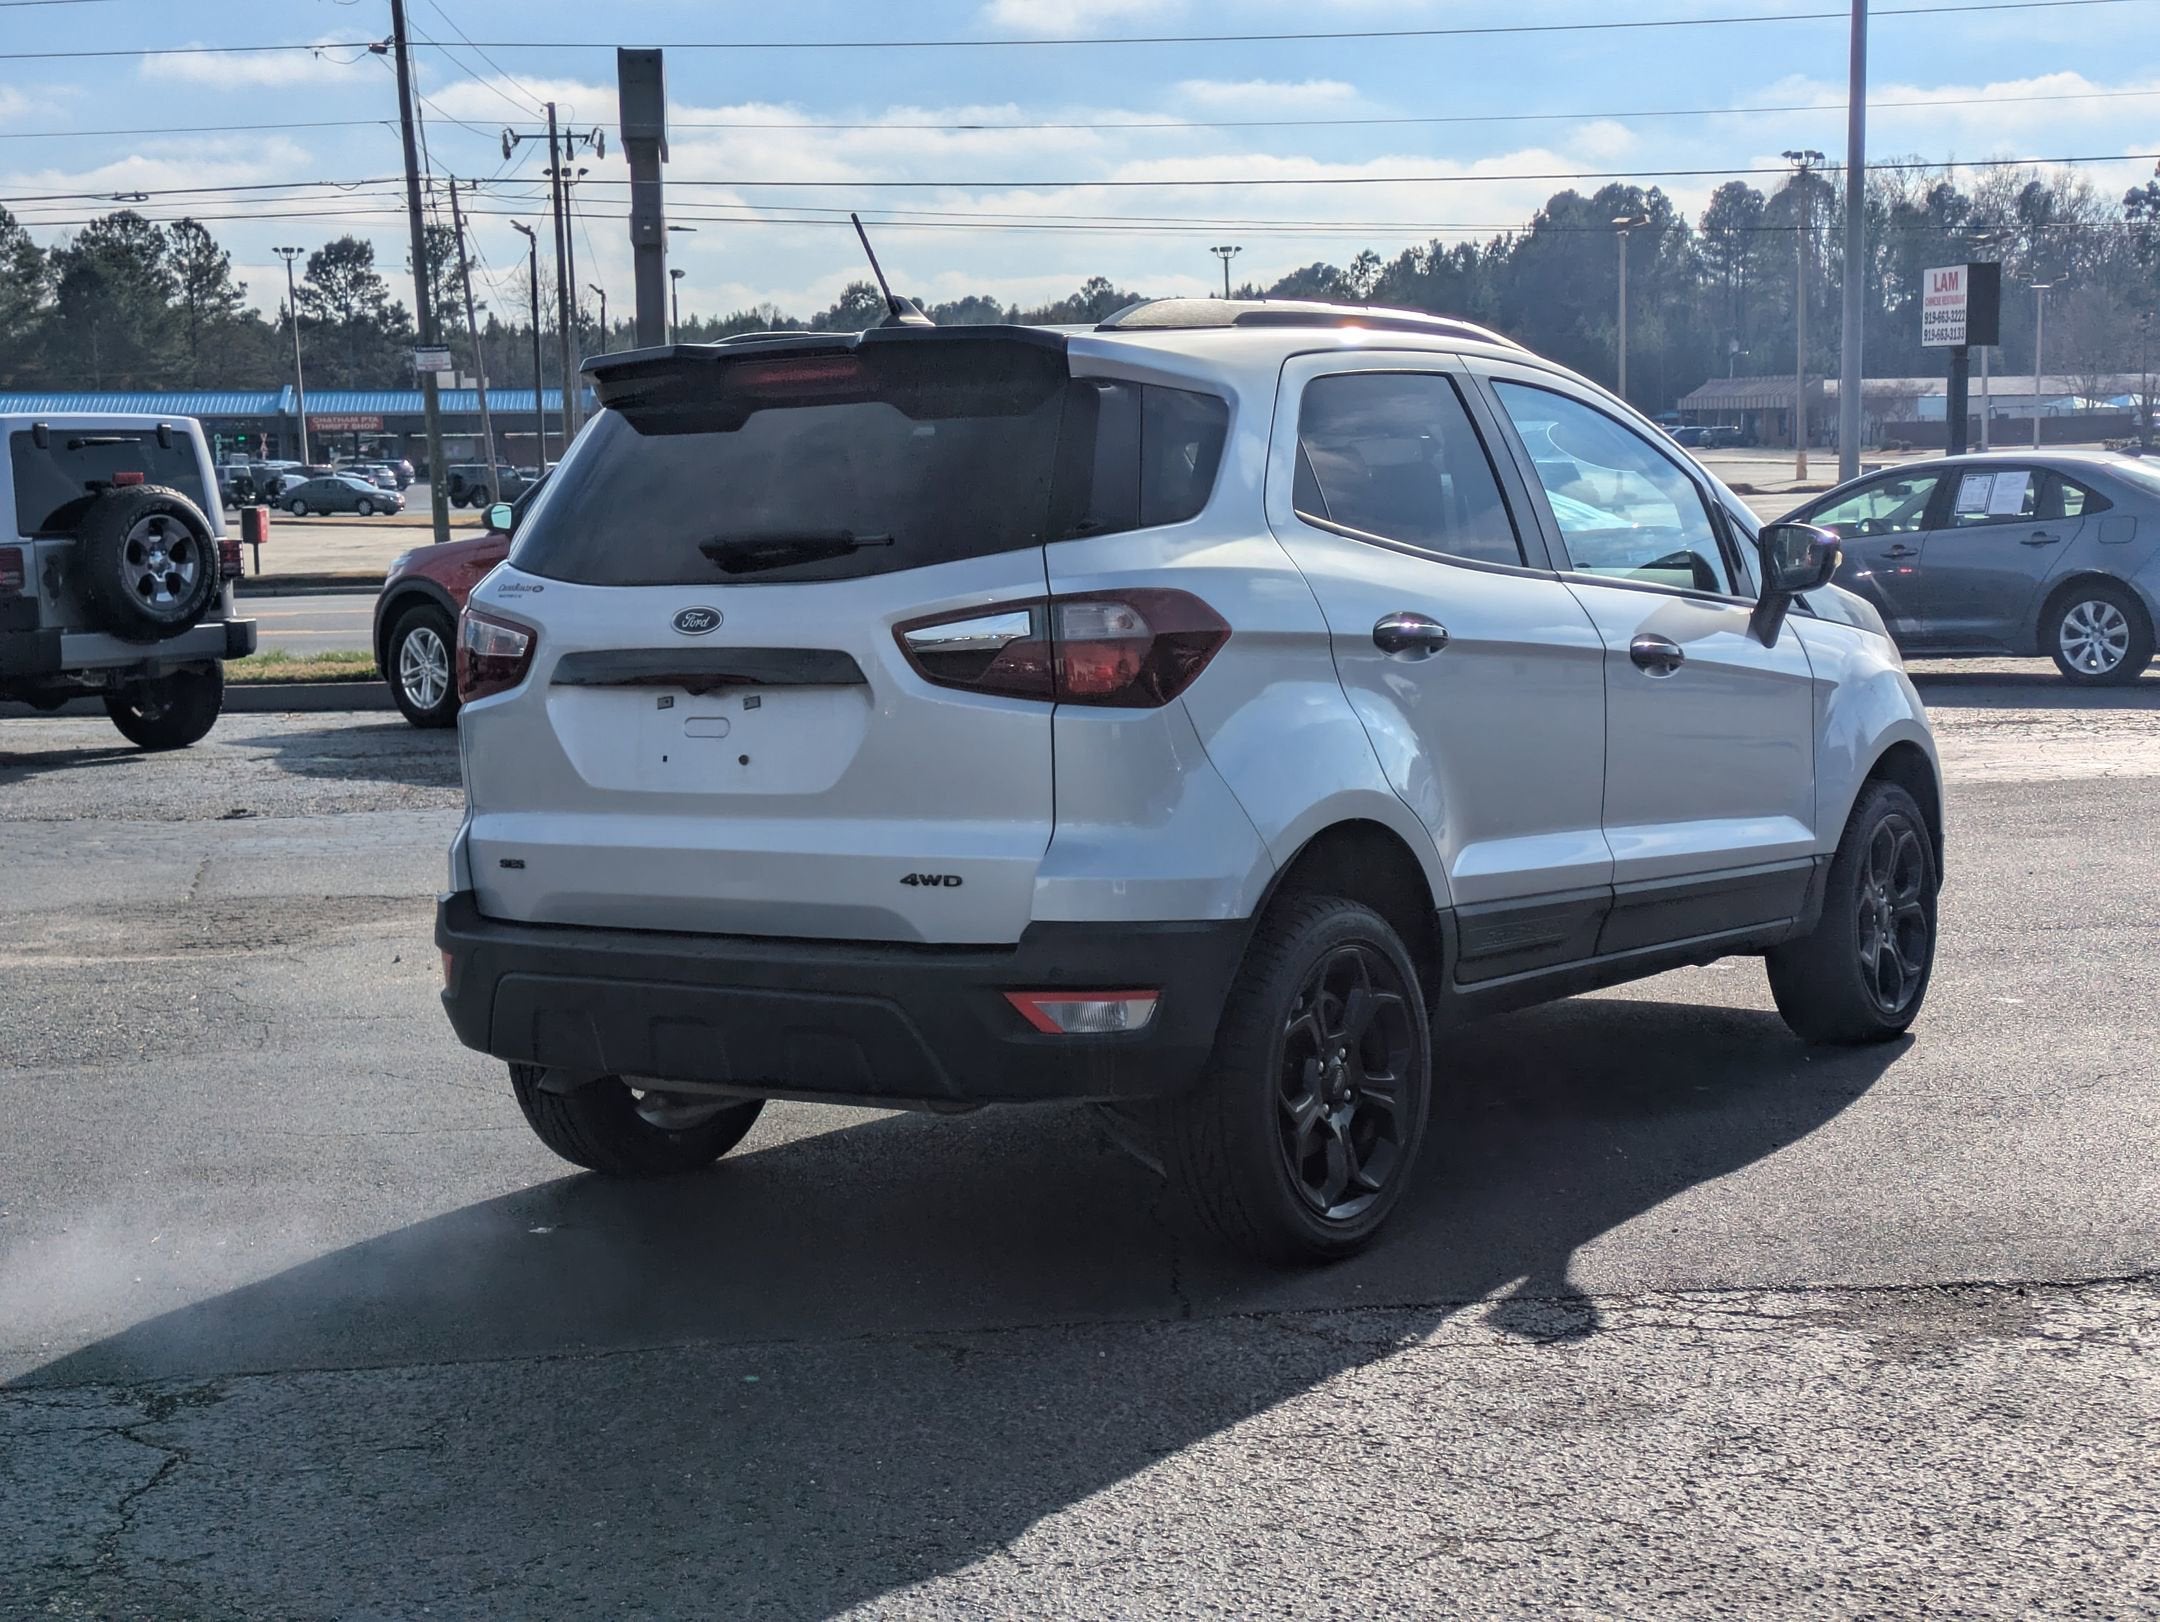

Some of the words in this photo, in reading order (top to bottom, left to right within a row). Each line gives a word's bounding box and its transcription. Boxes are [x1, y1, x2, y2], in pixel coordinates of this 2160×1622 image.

[1933, 271, 1959, 293] LAM
[312, 416, 359, 424] CHATHAM
[361, 416, 380, 424] PTA
[316, 423, 350, 431] THRIFT
[351, 423, 378, 431] SHOP
[681, 612, 710, 628] Ford
[900, 873, 963, 887] 4WD
